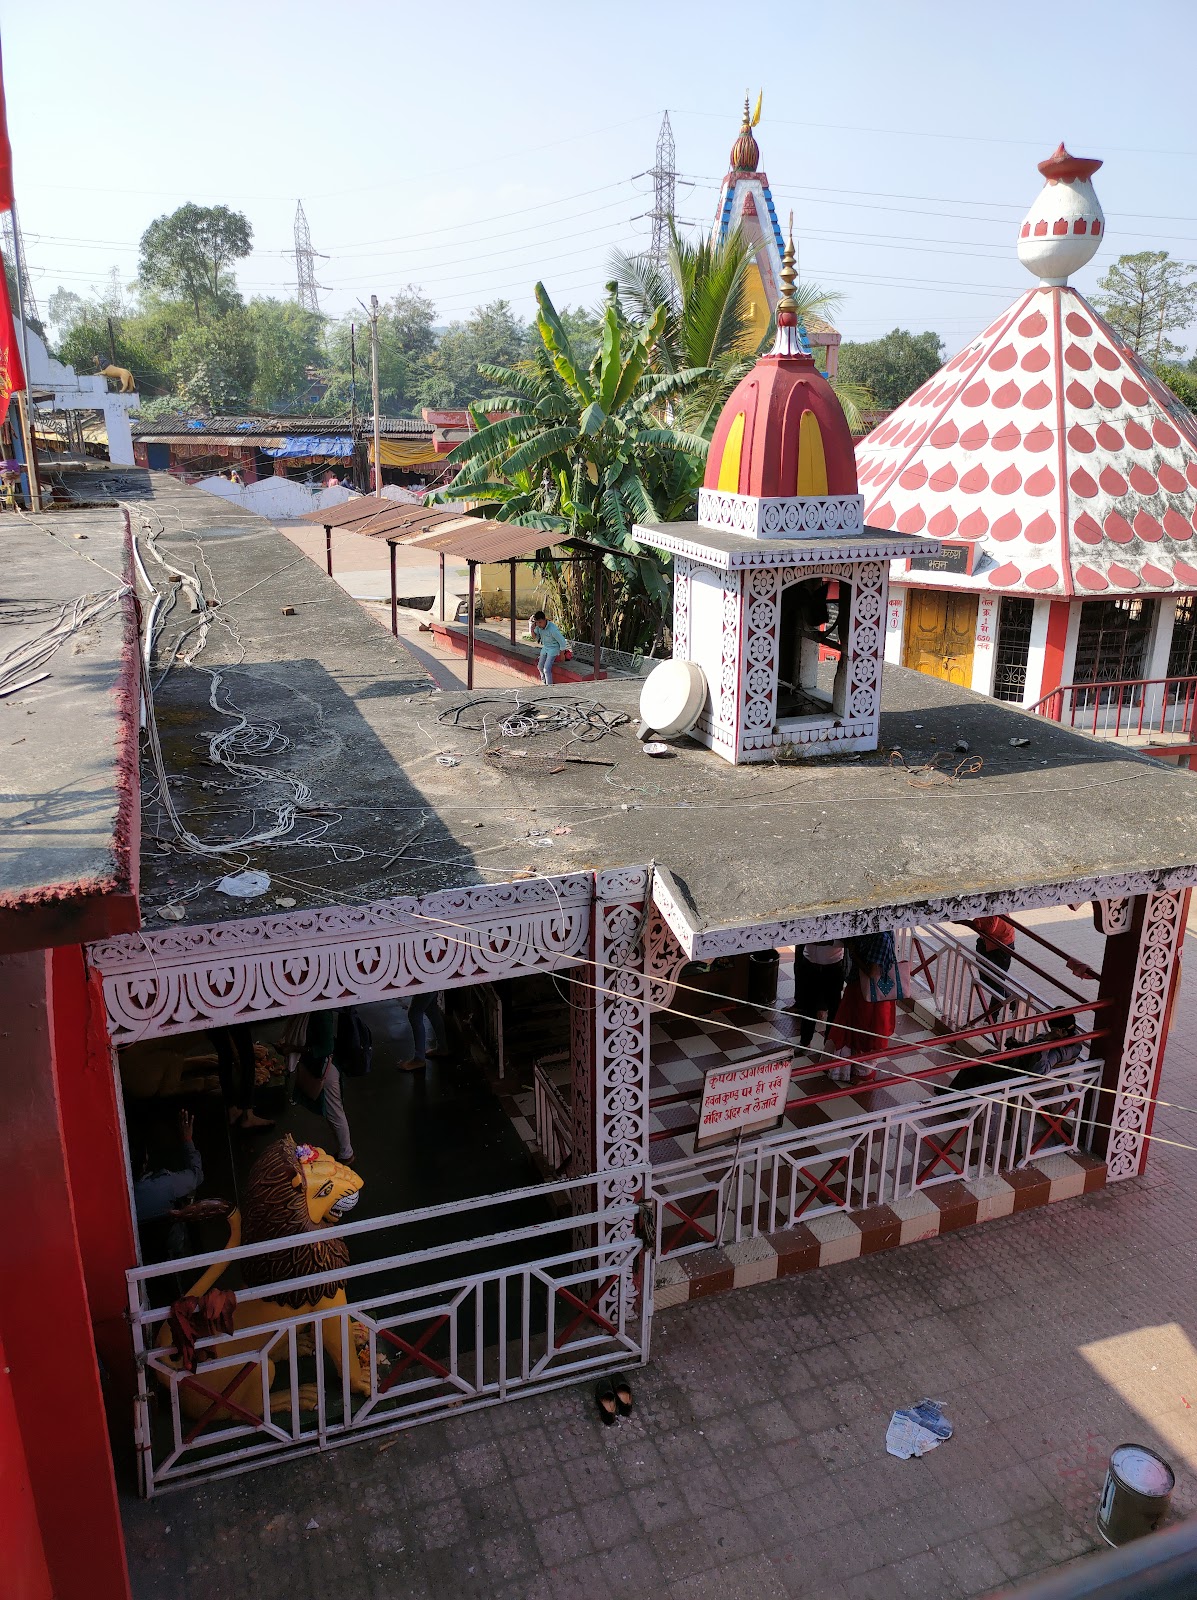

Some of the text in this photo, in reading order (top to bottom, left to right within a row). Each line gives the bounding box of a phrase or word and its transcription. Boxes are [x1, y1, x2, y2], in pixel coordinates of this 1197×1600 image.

[929, 560, 948, 570] भवन
[708, 1072, 737, 1090] कृपया
[741, 1086, 752, 1098] पर
[755, 1080, 766, 1095] ही
[703, 1110, 723, 1125] मंदिर
[724, 1105, 742, 1121] अंदर
[743, 1103, 752, 1114] न
